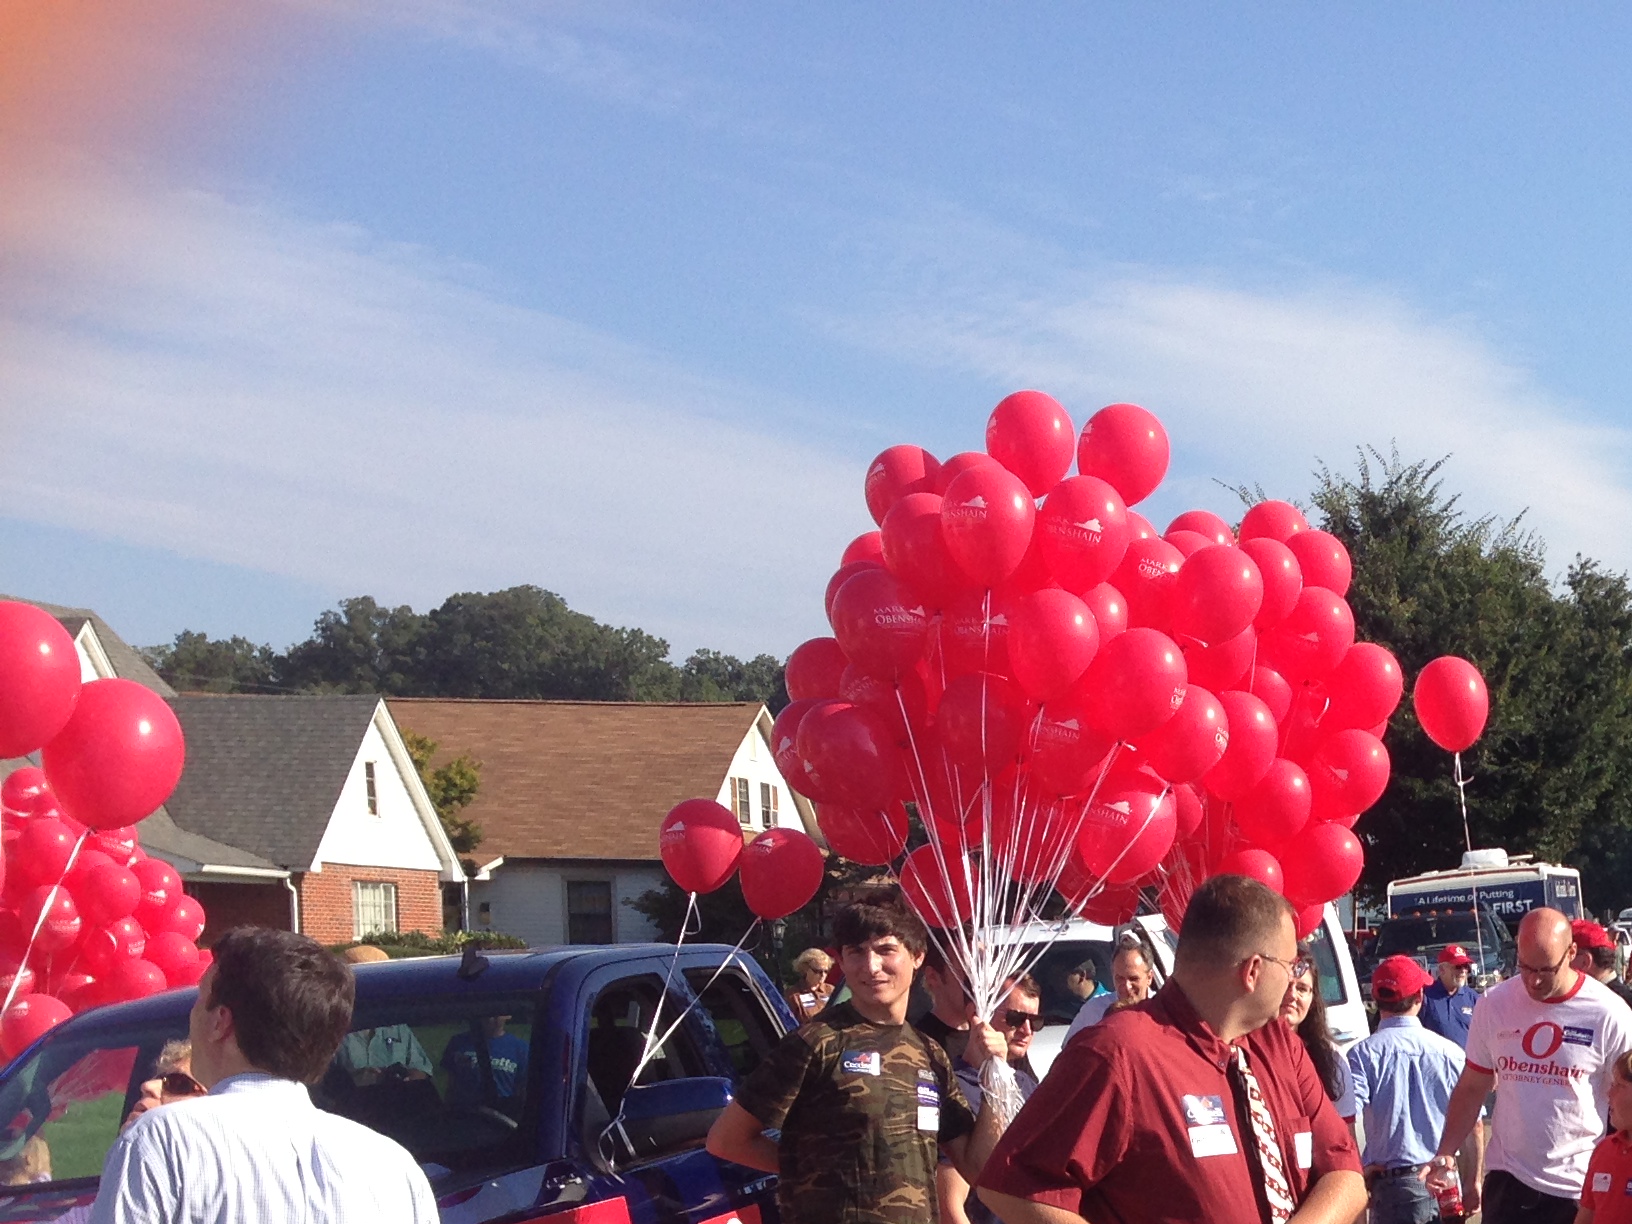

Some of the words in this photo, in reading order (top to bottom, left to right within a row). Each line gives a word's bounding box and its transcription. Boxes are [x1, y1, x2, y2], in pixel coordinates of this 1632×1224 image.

[1426, 893, 1466, 904] Lifetime
[1479, 889, 1515, 900] Putting
[1492, 899, 1533, 915] FIRST
[1522, 1021, 1564, 1060] O
